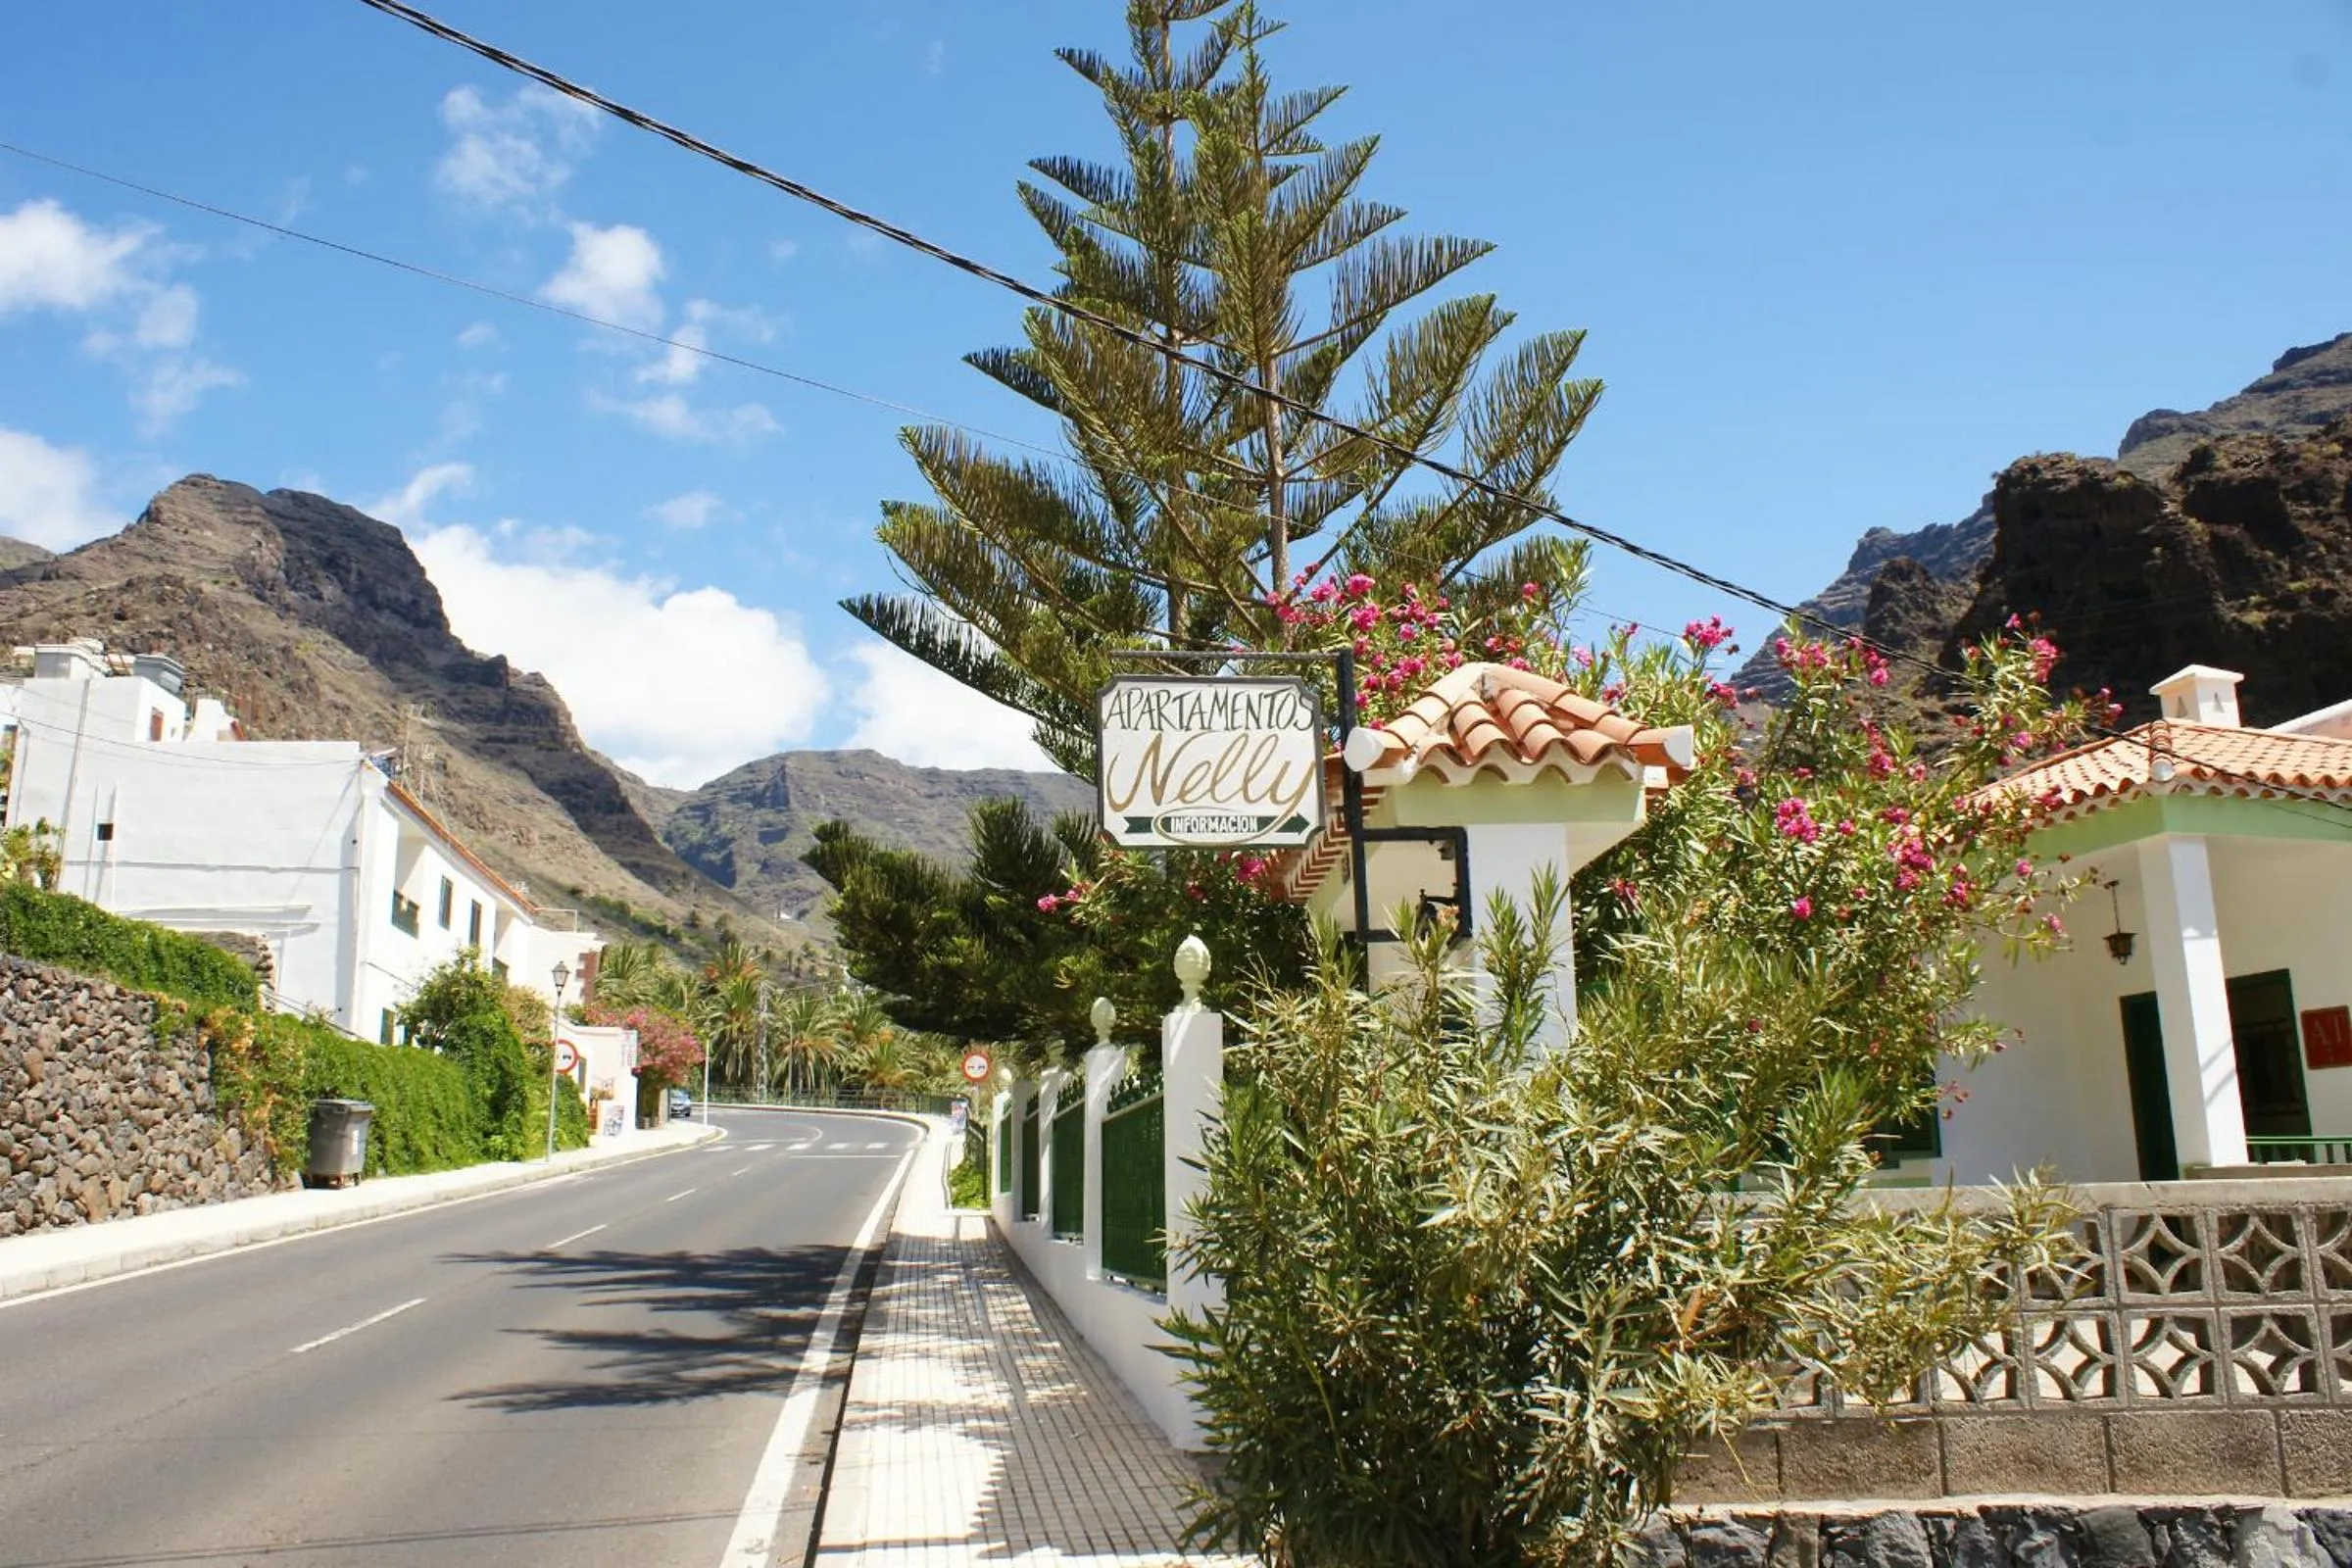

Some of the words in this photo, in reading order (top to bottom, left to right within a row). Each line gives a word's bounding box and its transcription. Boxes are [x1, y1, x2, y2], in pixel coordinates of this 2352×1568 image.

[1103, 685, 1314, 732] APARTAMENTOS
[1106, 730, 1316, 844] Nelly
[1170, 815, 1258, 833] INFORMACION
